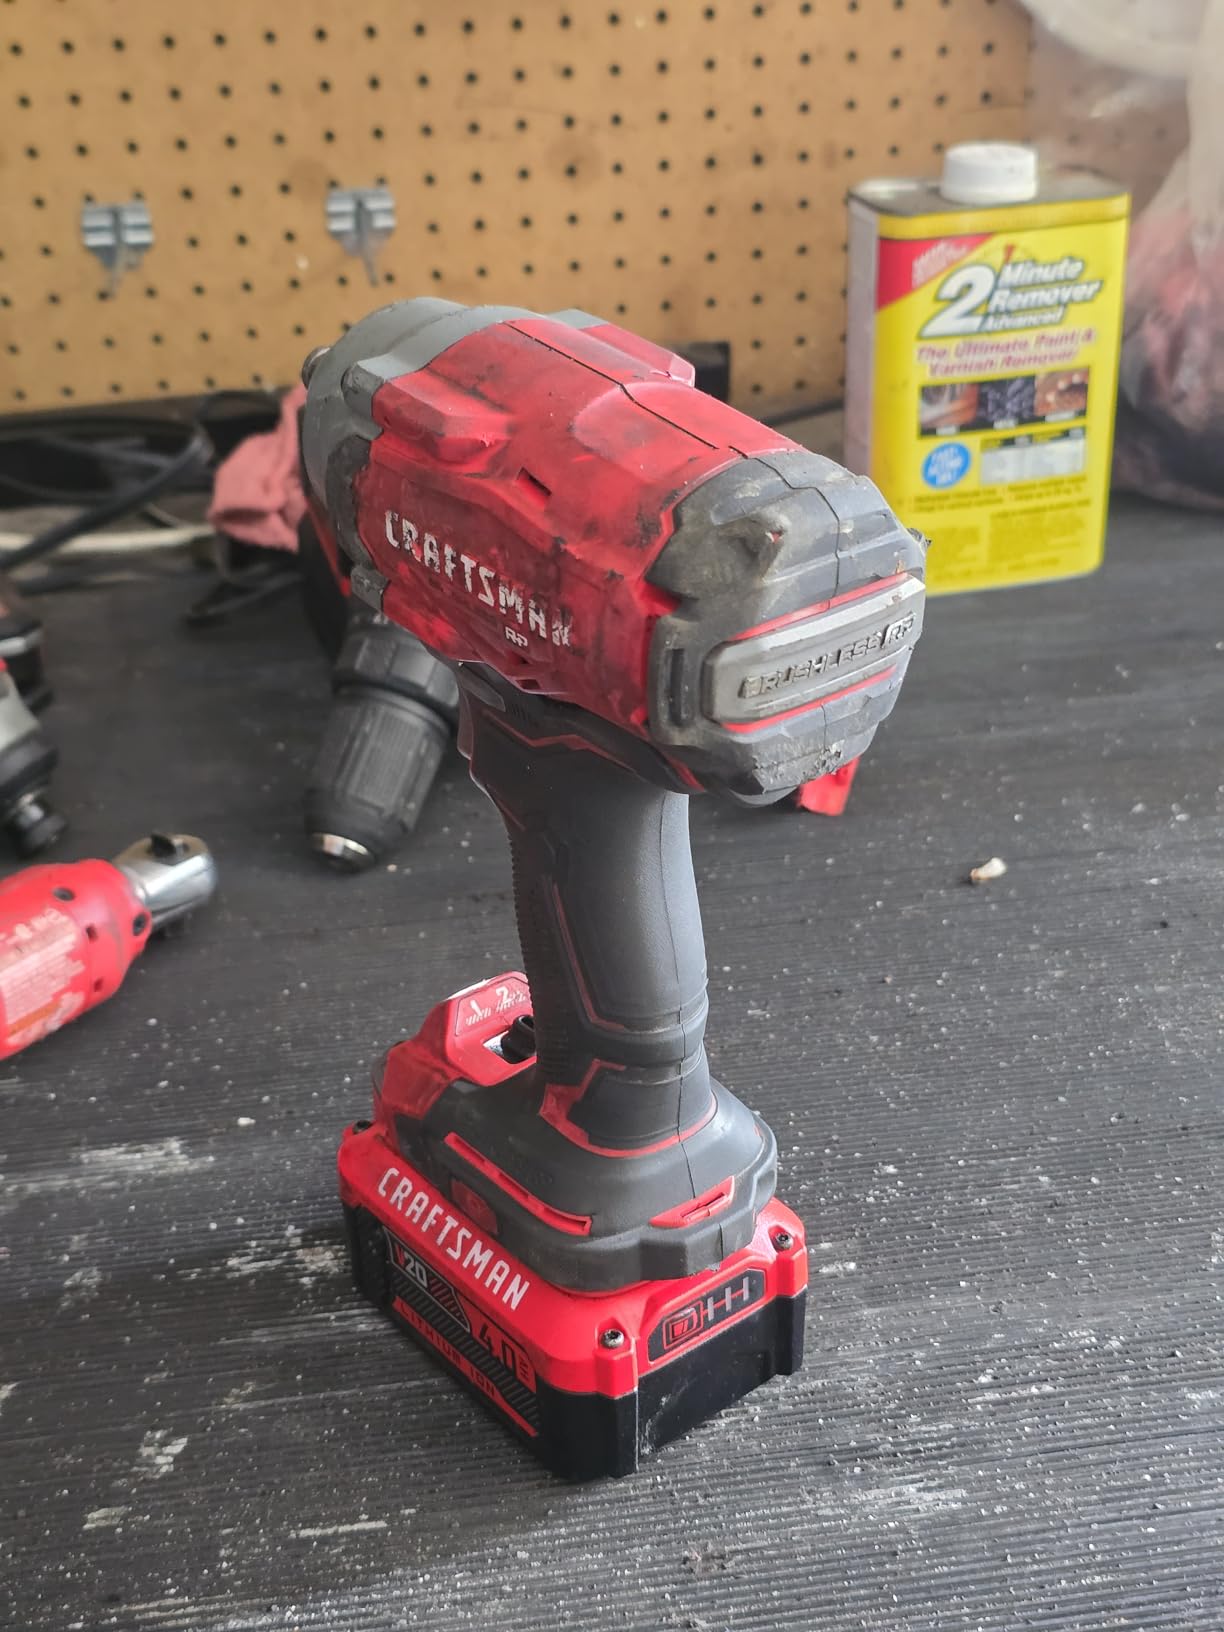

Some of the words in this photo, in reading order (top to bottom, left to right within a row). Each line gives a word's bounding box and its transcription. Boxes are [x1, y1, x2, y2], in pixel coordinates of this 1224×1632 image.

[919, 263, 996, 340] 2
[999, 256, 1084, 288] Minute
[986, 281, 1102, 315] Remover
[917, 346, 948, 362] The
[955, 339, 1028, 357] Ultimate
[1034, 331, 1076, 348] Paint
[377, 1167, 530, 1311] CRAFTSMAN
